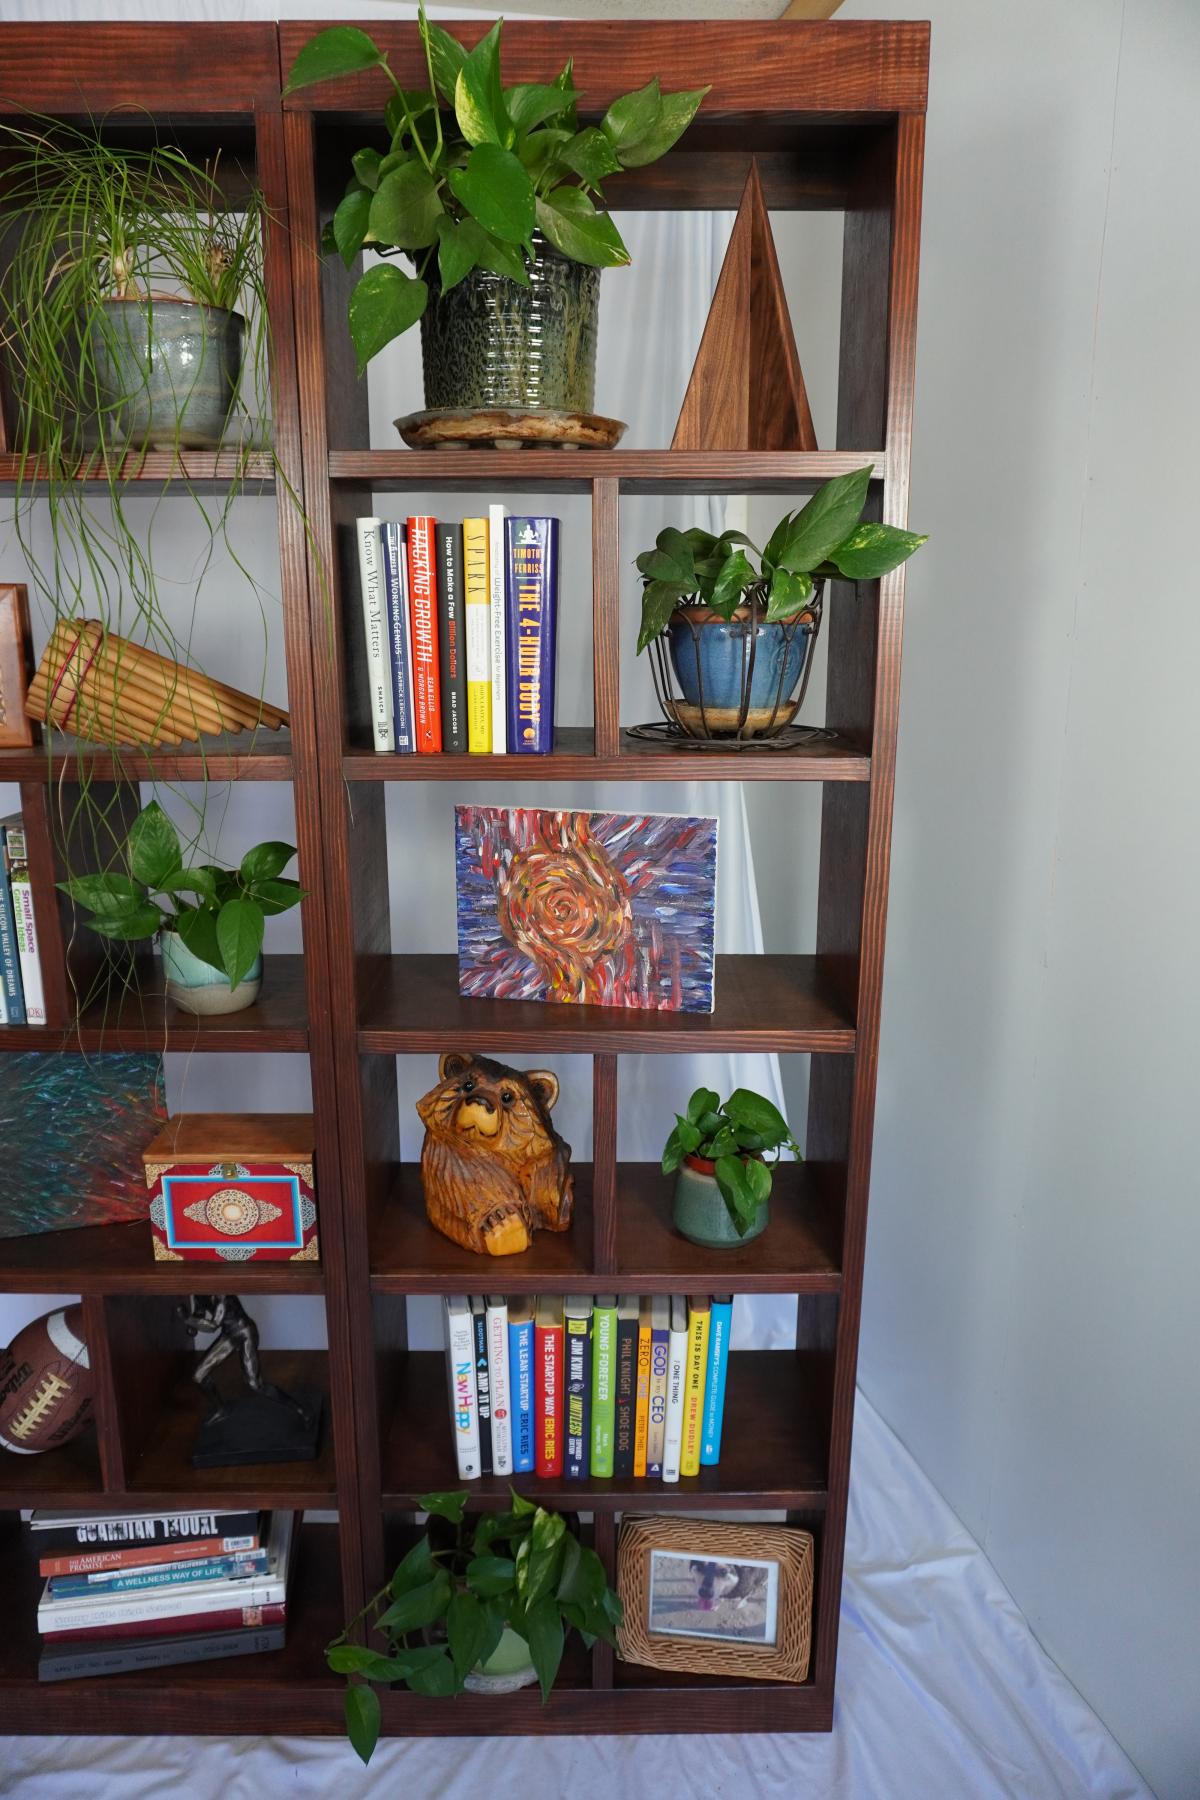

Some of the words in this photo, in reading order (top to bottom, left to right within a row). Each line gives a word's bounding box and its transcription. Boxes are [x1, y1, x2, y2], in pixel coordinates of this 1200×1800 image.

[363, 530, 375, 565] Know
[445, 537, 453, 556] How
[513, 549, 544, 558] TIMOTHY
[446, 558, 454, 566] to
[467, 536, 485, 594] SPARK
[514, 563, 544, 574] FERRISS
[366, 571, 378, 606] What
[447, 569, 455, 592] Make
[390, 578, 399, 621] WORKING
[448, 602, 456, 619] Few
[493, 577, 502, 628] Weight-Free
[519, 584, 540, 612] THE
[370, 611, 381, 658] Matters
[393, 622, 402, 655] GENIUS
[415, 599, 432, 662] GROWTH
[448, 621, 456, 646] Billion
[494, 630, 502, 663] Exercise
[519, 618, 540, 676] 4-HOUR
[449, 648, 457, 678] Dollars
[519, 682, 541, 722] BODY
[0, 904, 9, 930] SILICON
[13, 889, 23, 924] Garden
[22, 890, 32, 920] Small
[2, 933, 11, 956] VALLEY
[17, 927, 26, 952] Ideas
[25, 922, 35, 953] Space
[5, 959, 13, 967] OF
[6, 970, 16, 997] DREAMS
[493, 1318, 503, 1365] GETTING
[520, 1329, 528, 1347] THE
[599, 1315, 609, 1351] YOUNG
[695, 1321, 703, 1340] THIS
[544, 1334, 554, 1353] THE
[571, 1338, 583, 1355] JIM
[622, 1338, 632, 1359] PHIL
[639, 1338, 649, 1366] ZERO
[694, 1344, 702, 1352] IS
[520, 1349, 528, 1372] LEAN
[570, 1357, 583, 1380] KWIK
[653, 1345, 666, 1376] GOD
[693, 1355, 701, 1371] DAY
[456, 1362, 473, 1394] New
[477, 1372, 489, 1392] AMP
[544, 1354, 554, 1395] STARTUP
[599, 1353, 609, 1400] FOREVER
[620, 1361, 631, 1395] KNIGHT
[692, 1374, 700, 1390] ONE
[479, 1394, 489, 1403] IT
[495, 1380, 505, 1407] PLAN
[520, 1374, 528, 1411] STARTUP
[456, 1395, 473, 1435] Happy
[479, 1406, 490, 1418] UP
[544, 1396, 554, 1416] WAY
[570, 1395, 582, 1436] LIMITLESS
[619, 1407, 630, 1429] SHOE
[652, 1396, 664, 1424] CEO
[689, 1397, 698, 1421] DREW
[545, 1418, 554, 1438] ERIC
[687, 1424, 696, 1455] DUDLEY
[545, 1440, 555, 1460] RIES
[618, 1432, 629, 1451] DOG
[69, 1562, 103, 1572] PROMISE
[80, 1553, 122, 1564] AMERICAN
[124, 1574, 171, 1586] WELLNESS
[171, 1572, 191, 1580] WAY
[205, 1567, 223, 1576] LIFE
